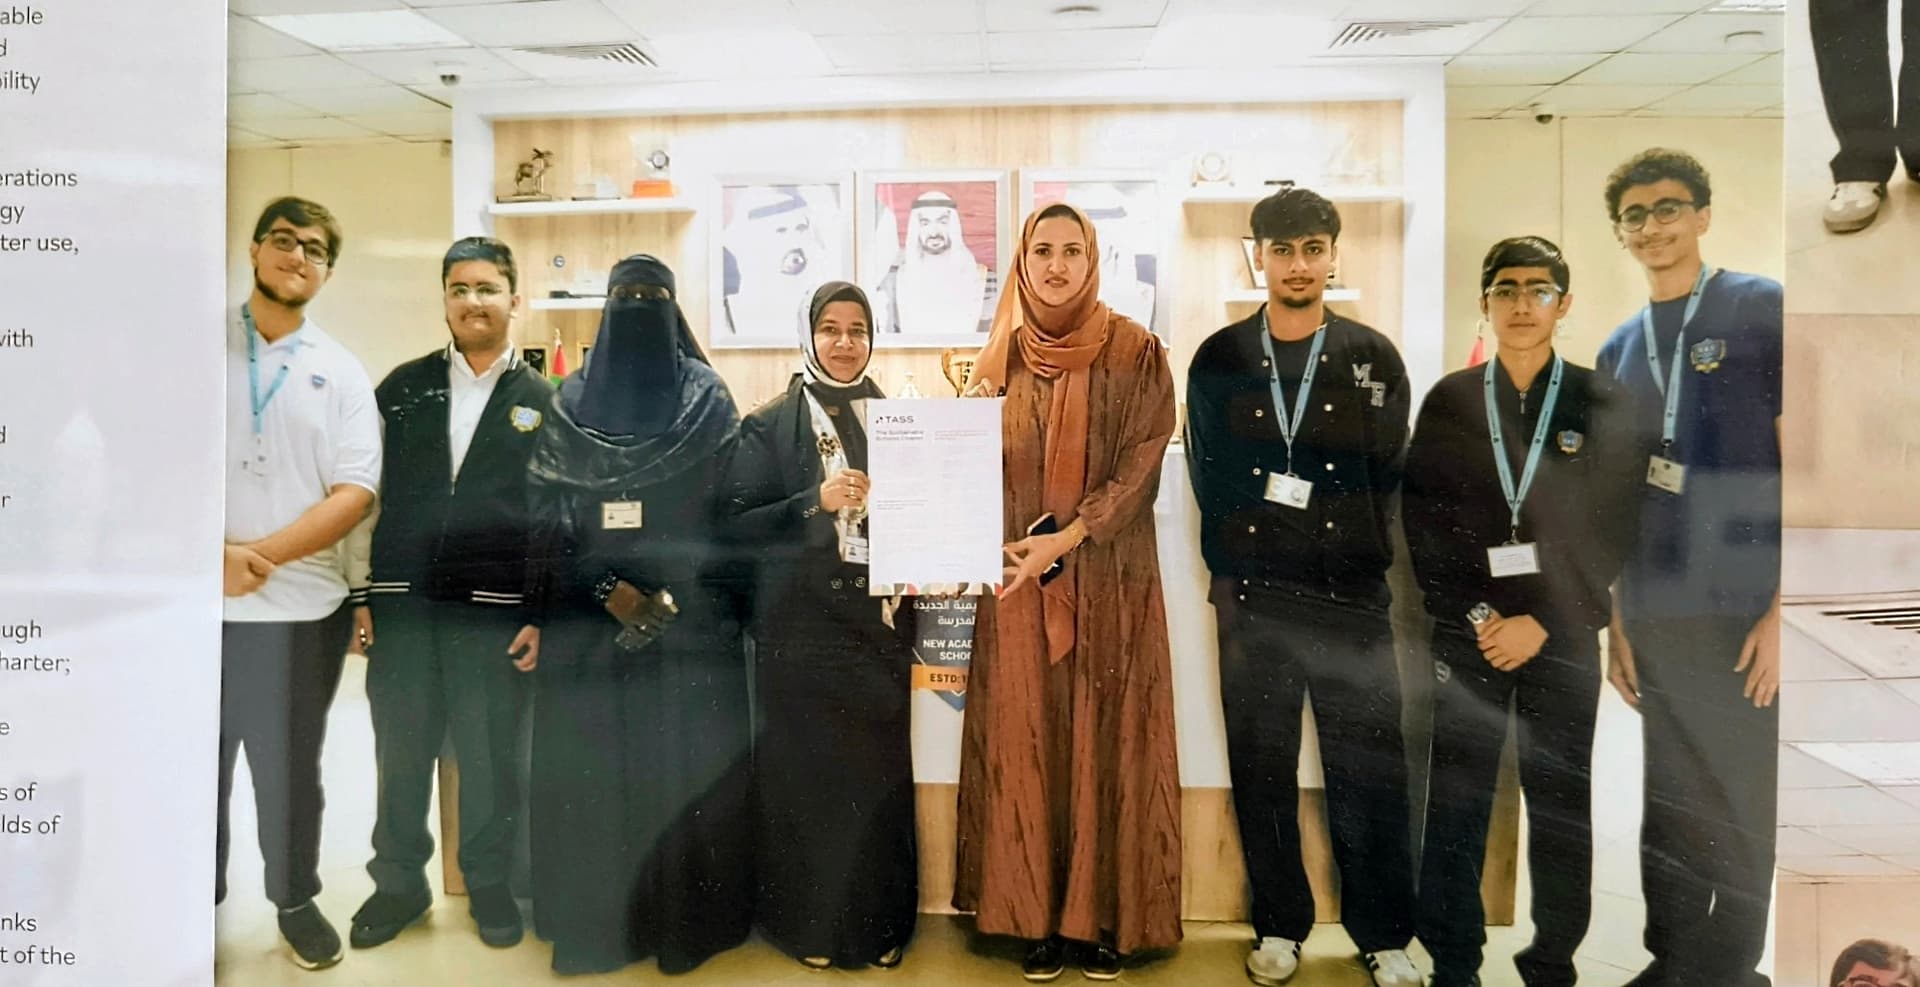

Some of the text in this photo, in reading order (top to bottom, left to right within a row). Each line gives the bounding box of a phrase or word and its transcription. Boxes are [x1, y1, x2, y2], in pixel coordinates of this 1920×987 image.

[0, 234, 79, 255] ter use,
[2, 619, 42, 645] ugh
[923, 639, 946, 648] NEW
[14, 781, 38, 801] of
[2, 814, 62, 834] lds of
[1, 912, 38, 932] nks
[13, 944, 37, 964] of
[40, 945, 76, 966] the
